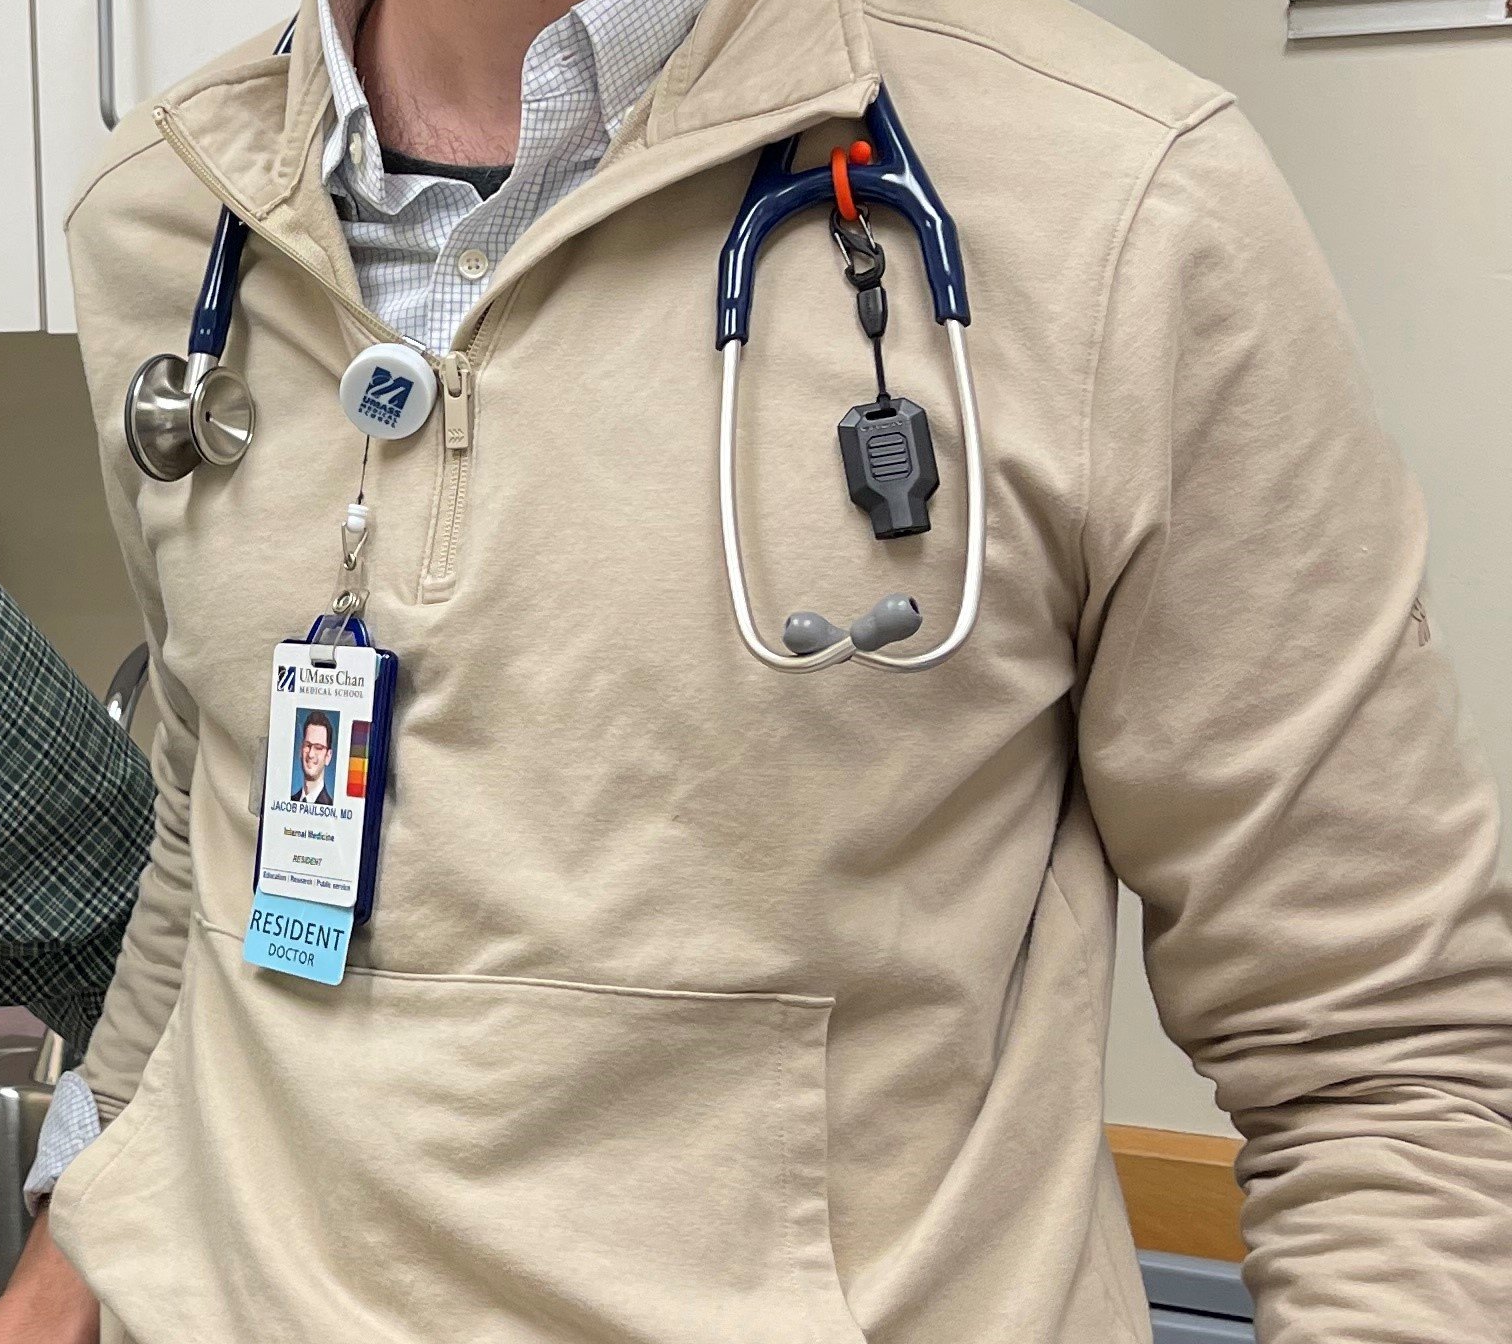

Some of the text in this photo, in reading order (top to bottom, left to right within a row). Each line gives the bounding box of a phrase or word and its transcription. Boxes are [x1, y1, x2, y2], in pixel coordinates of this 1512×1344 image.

[299, 668, 365, 687] UMass Chan
[299, 686, 364, 698] MEDICAL SCHOOL
[271, 800, 353, 820] JACOB PAULSON, MD
[249, 909, 345, 951] RESIDENT
[268, 943, 315, 967] DOCTOR
